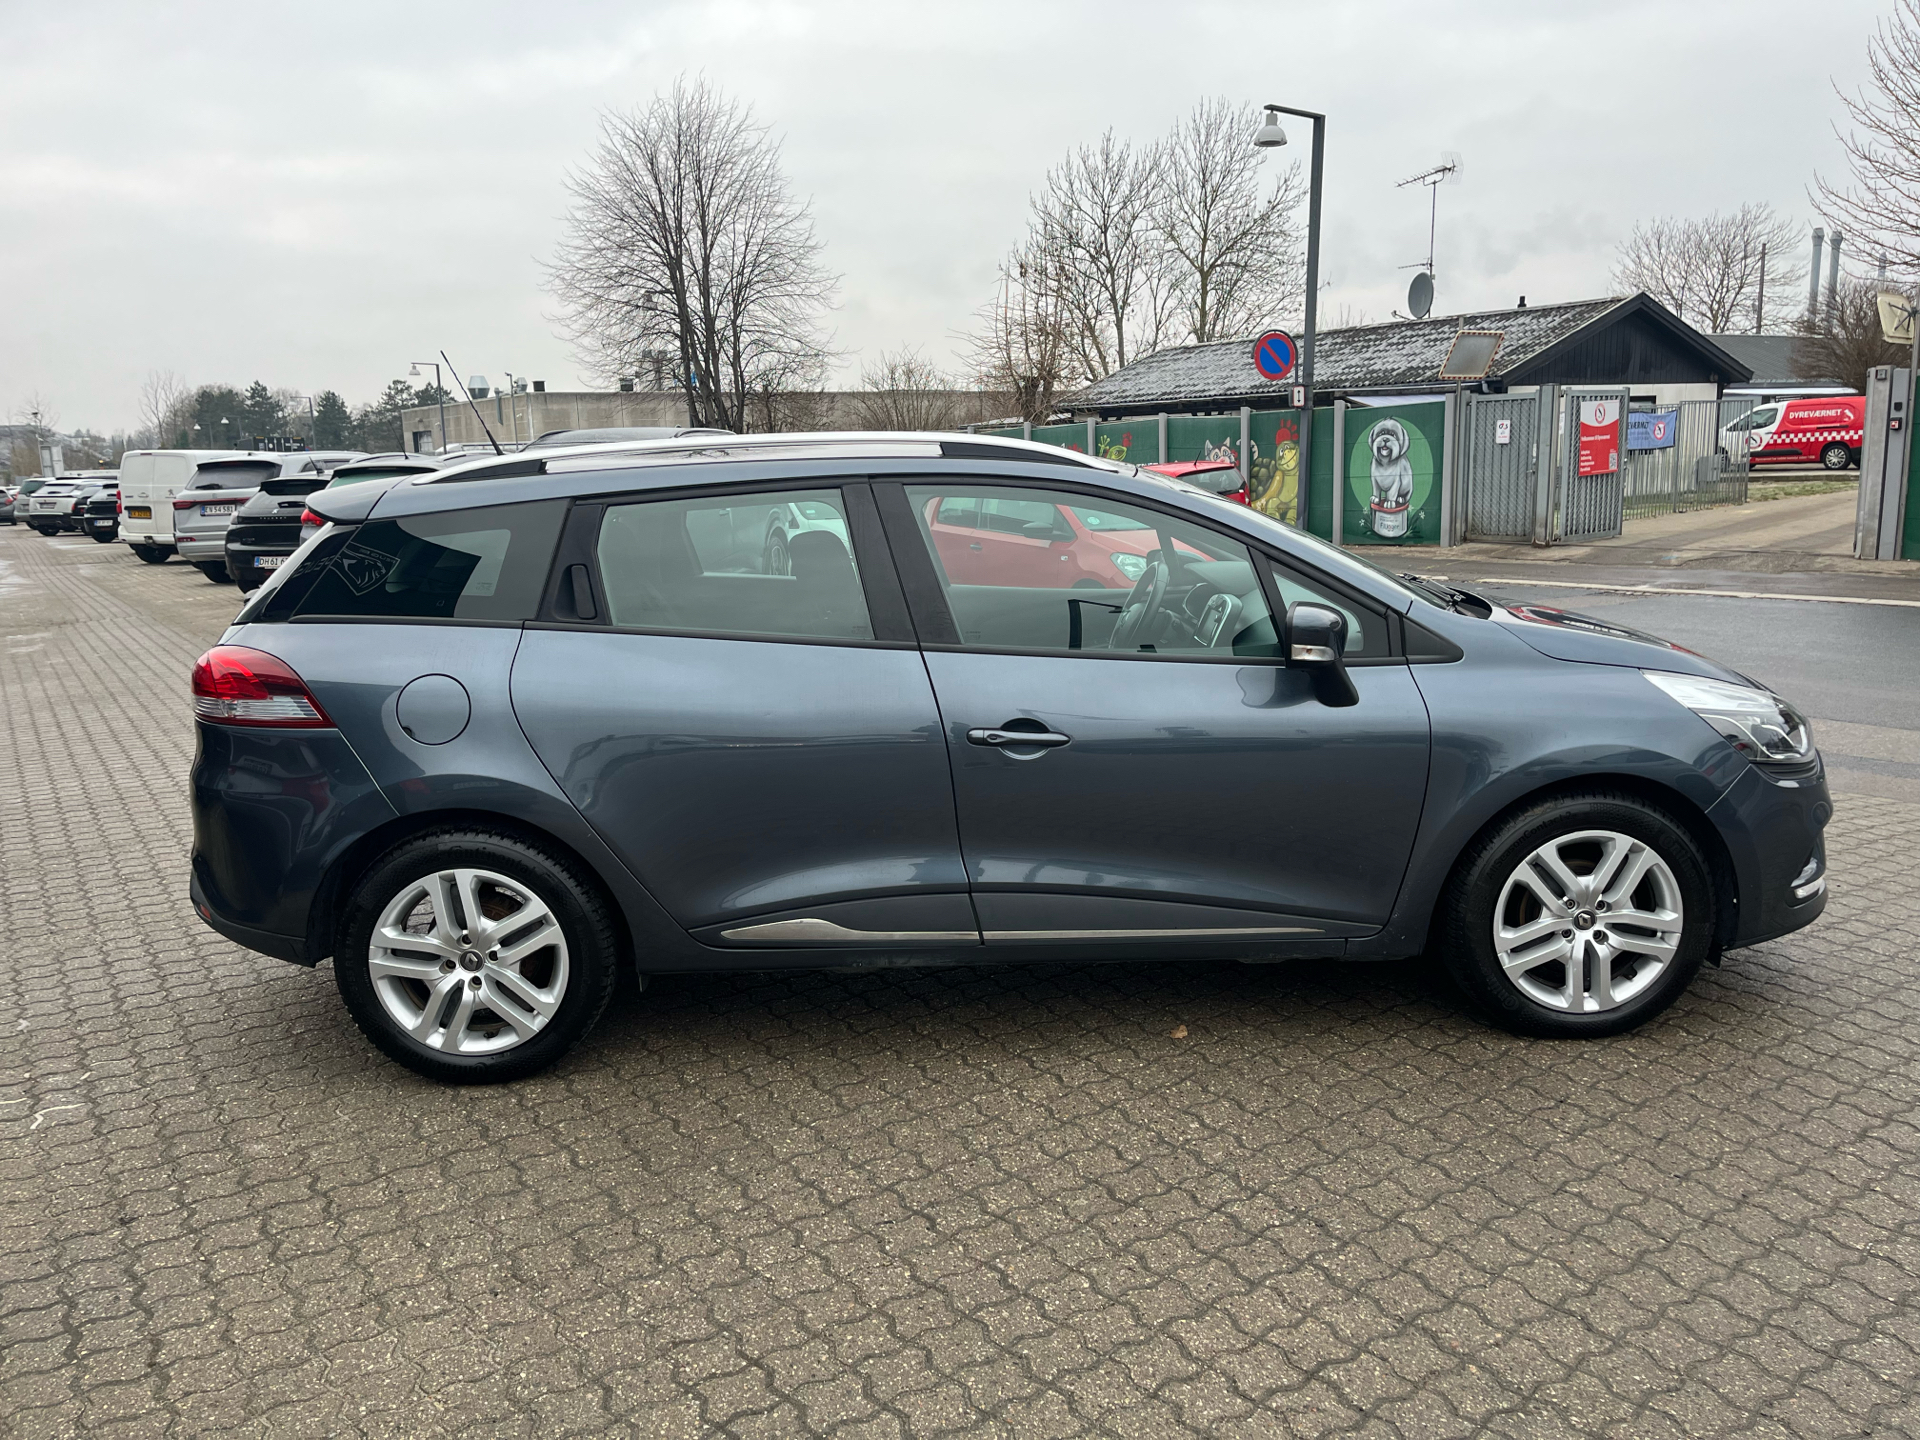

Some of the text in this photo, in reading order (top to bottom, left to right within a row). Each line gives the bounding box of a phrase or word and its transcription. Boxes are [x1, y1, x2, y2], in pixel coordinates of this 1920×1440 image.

[1789, 408, 1842, 419] DYREVÆRNET
[223, 505, 233, 513] 581
[259, 557, 288, 566] DH 61 6
